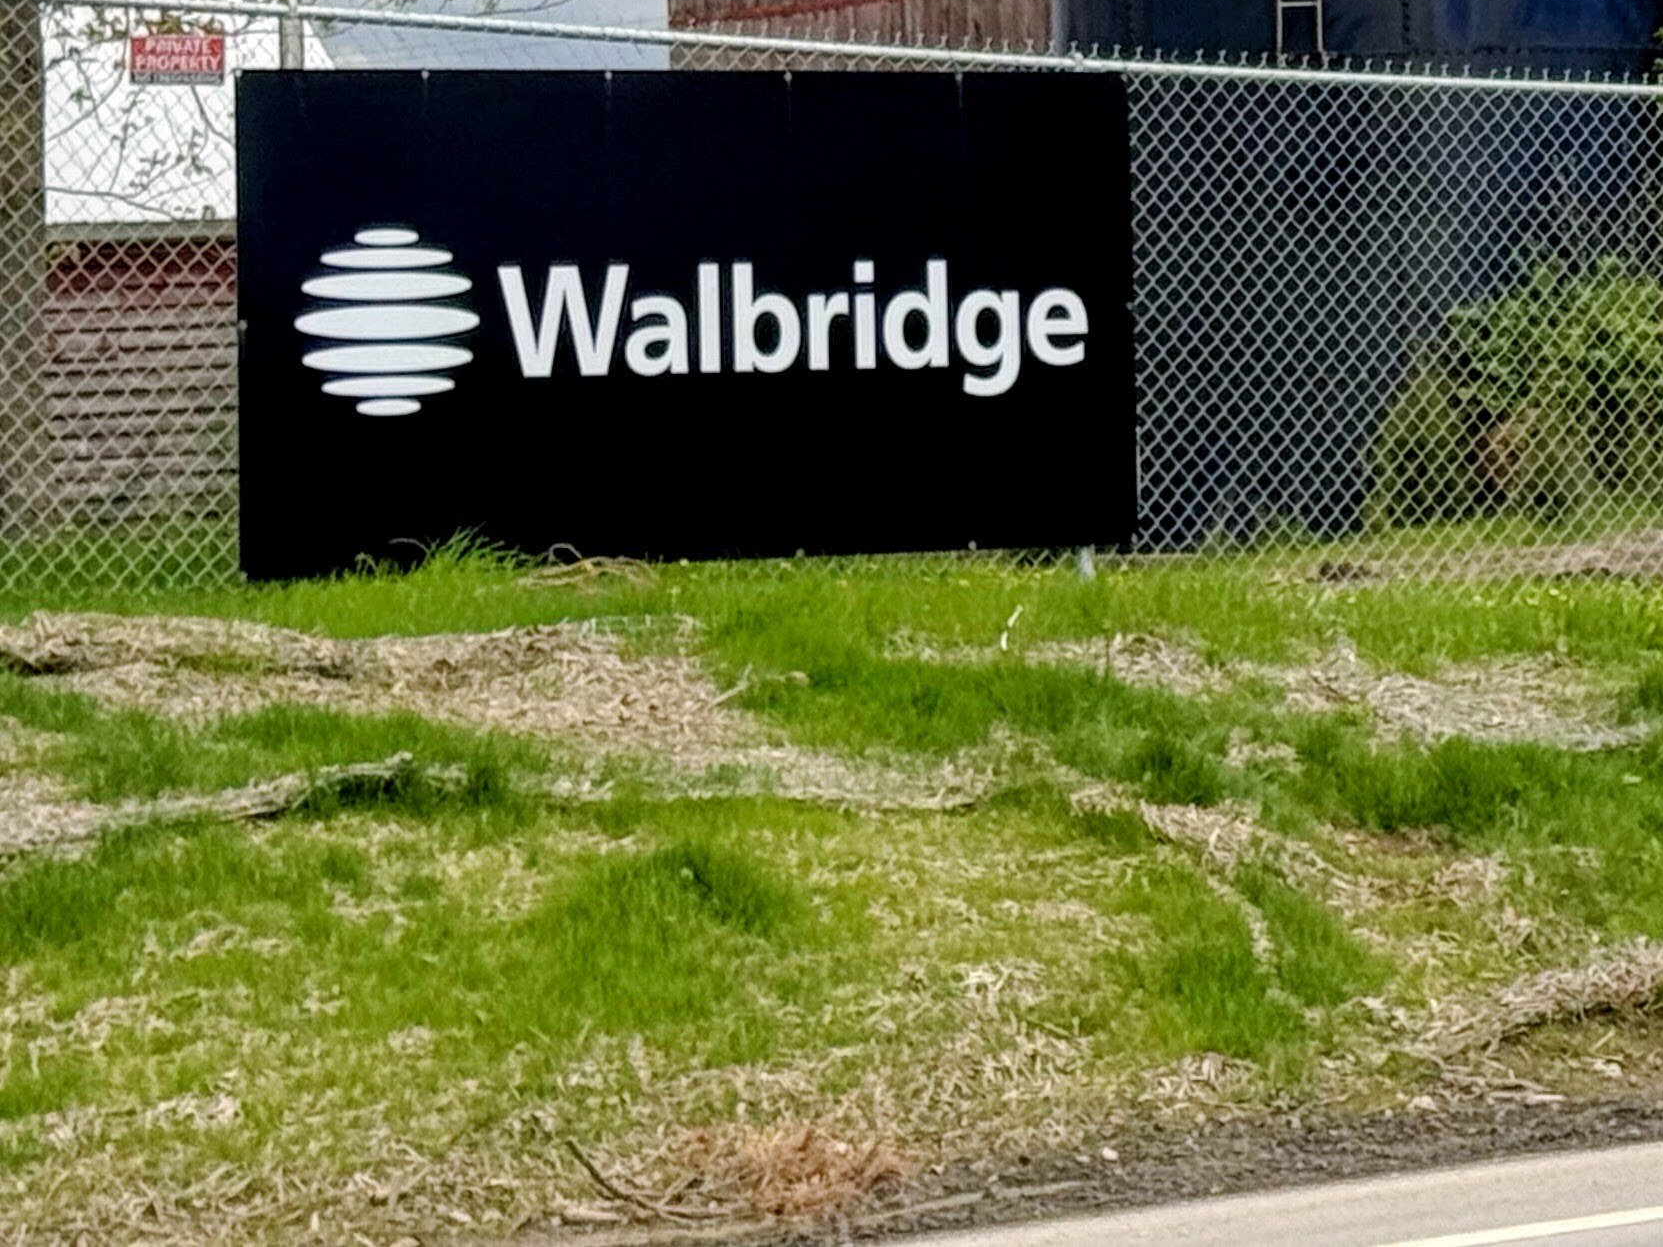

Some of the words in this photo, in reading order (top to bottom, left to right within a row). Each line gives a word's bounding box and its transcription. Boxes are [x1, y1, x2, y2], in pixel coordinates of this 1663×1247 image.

[145, 38, 213, 54] PRIVATE
[134, 54, 222, 71] PROPERTY
[497, 259, 1089, 397] Walbridge
